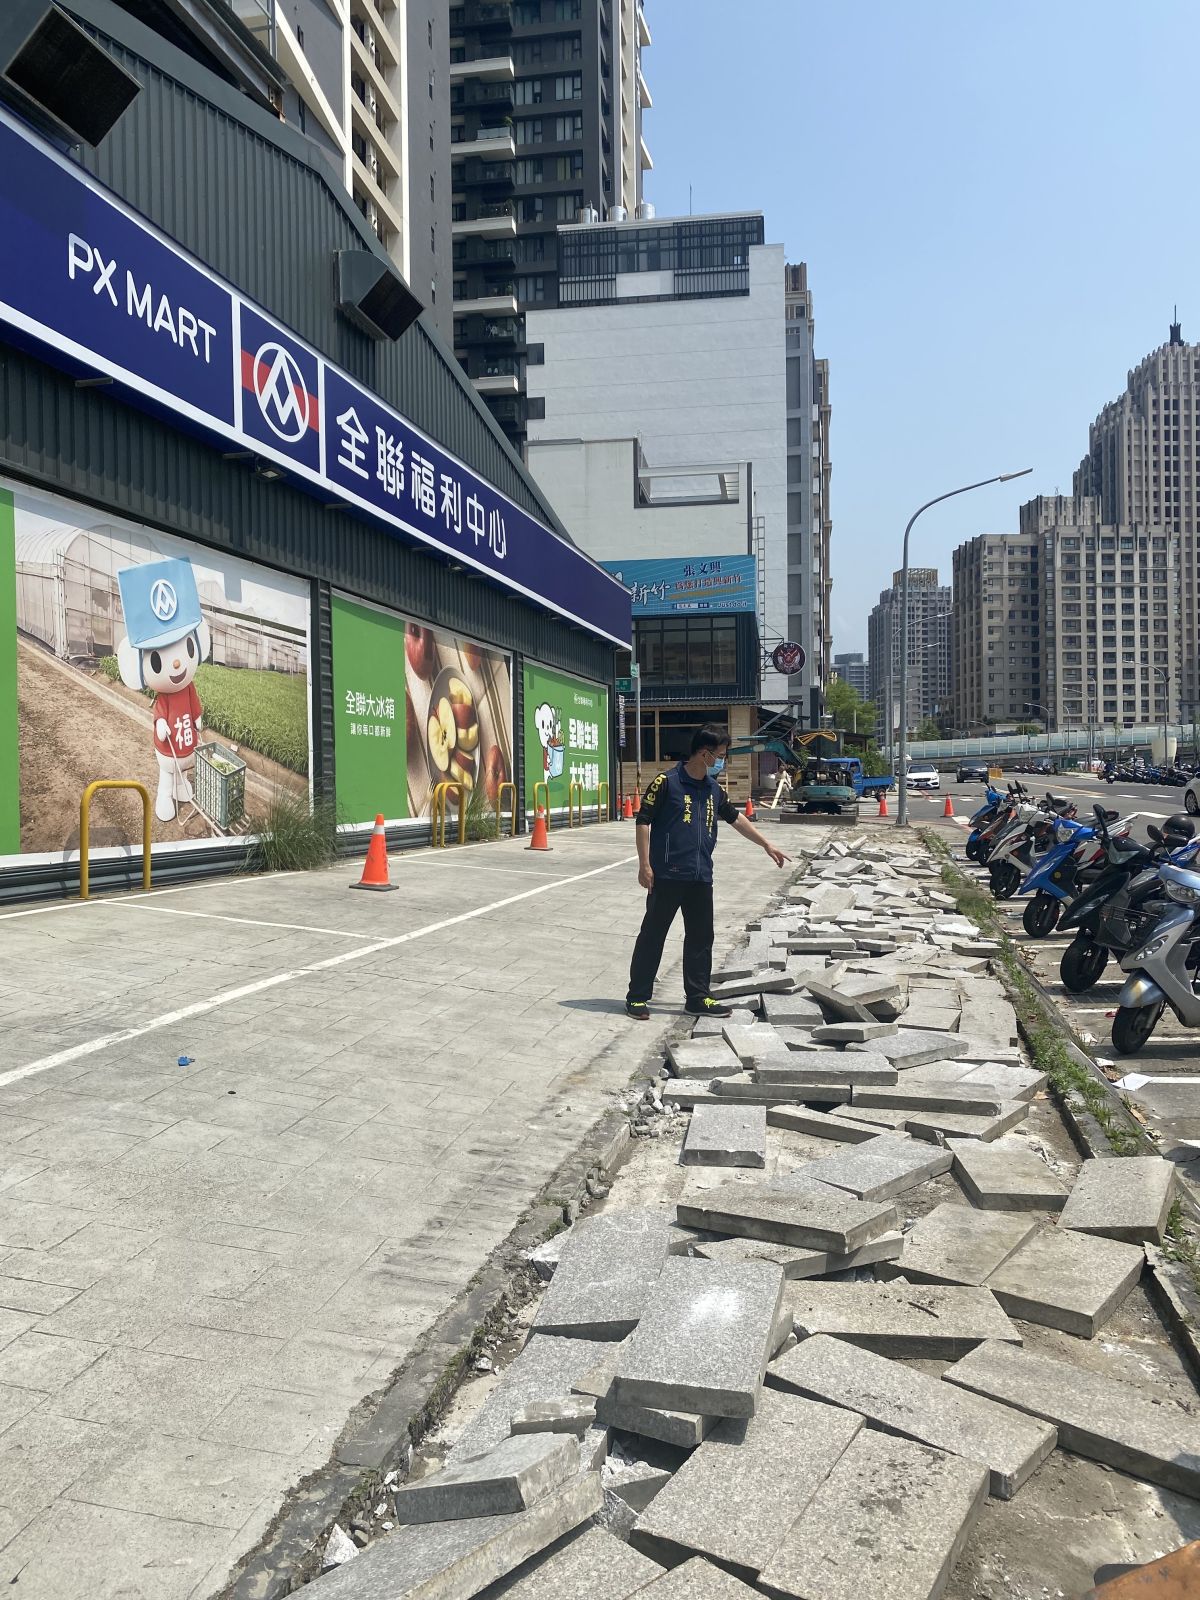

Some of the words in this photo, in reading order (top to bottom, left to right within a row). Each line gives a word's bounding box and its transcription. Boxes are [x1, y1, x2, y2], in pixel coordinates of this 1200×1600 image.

[68, 232, 118, 307] PX
[126, 269, 217, 364] MART
[335, 406, 507, 560] 全聯福利中心
[683, 561, 722, 577] 張文興
[345, 689, 395, 720] 全聯大冰箱
[174, 713, 194, 751] 福
[350, 722, 391, 738] 讓你每口都新鮮
[568, 718, 599, 751] 全聯生鮮
